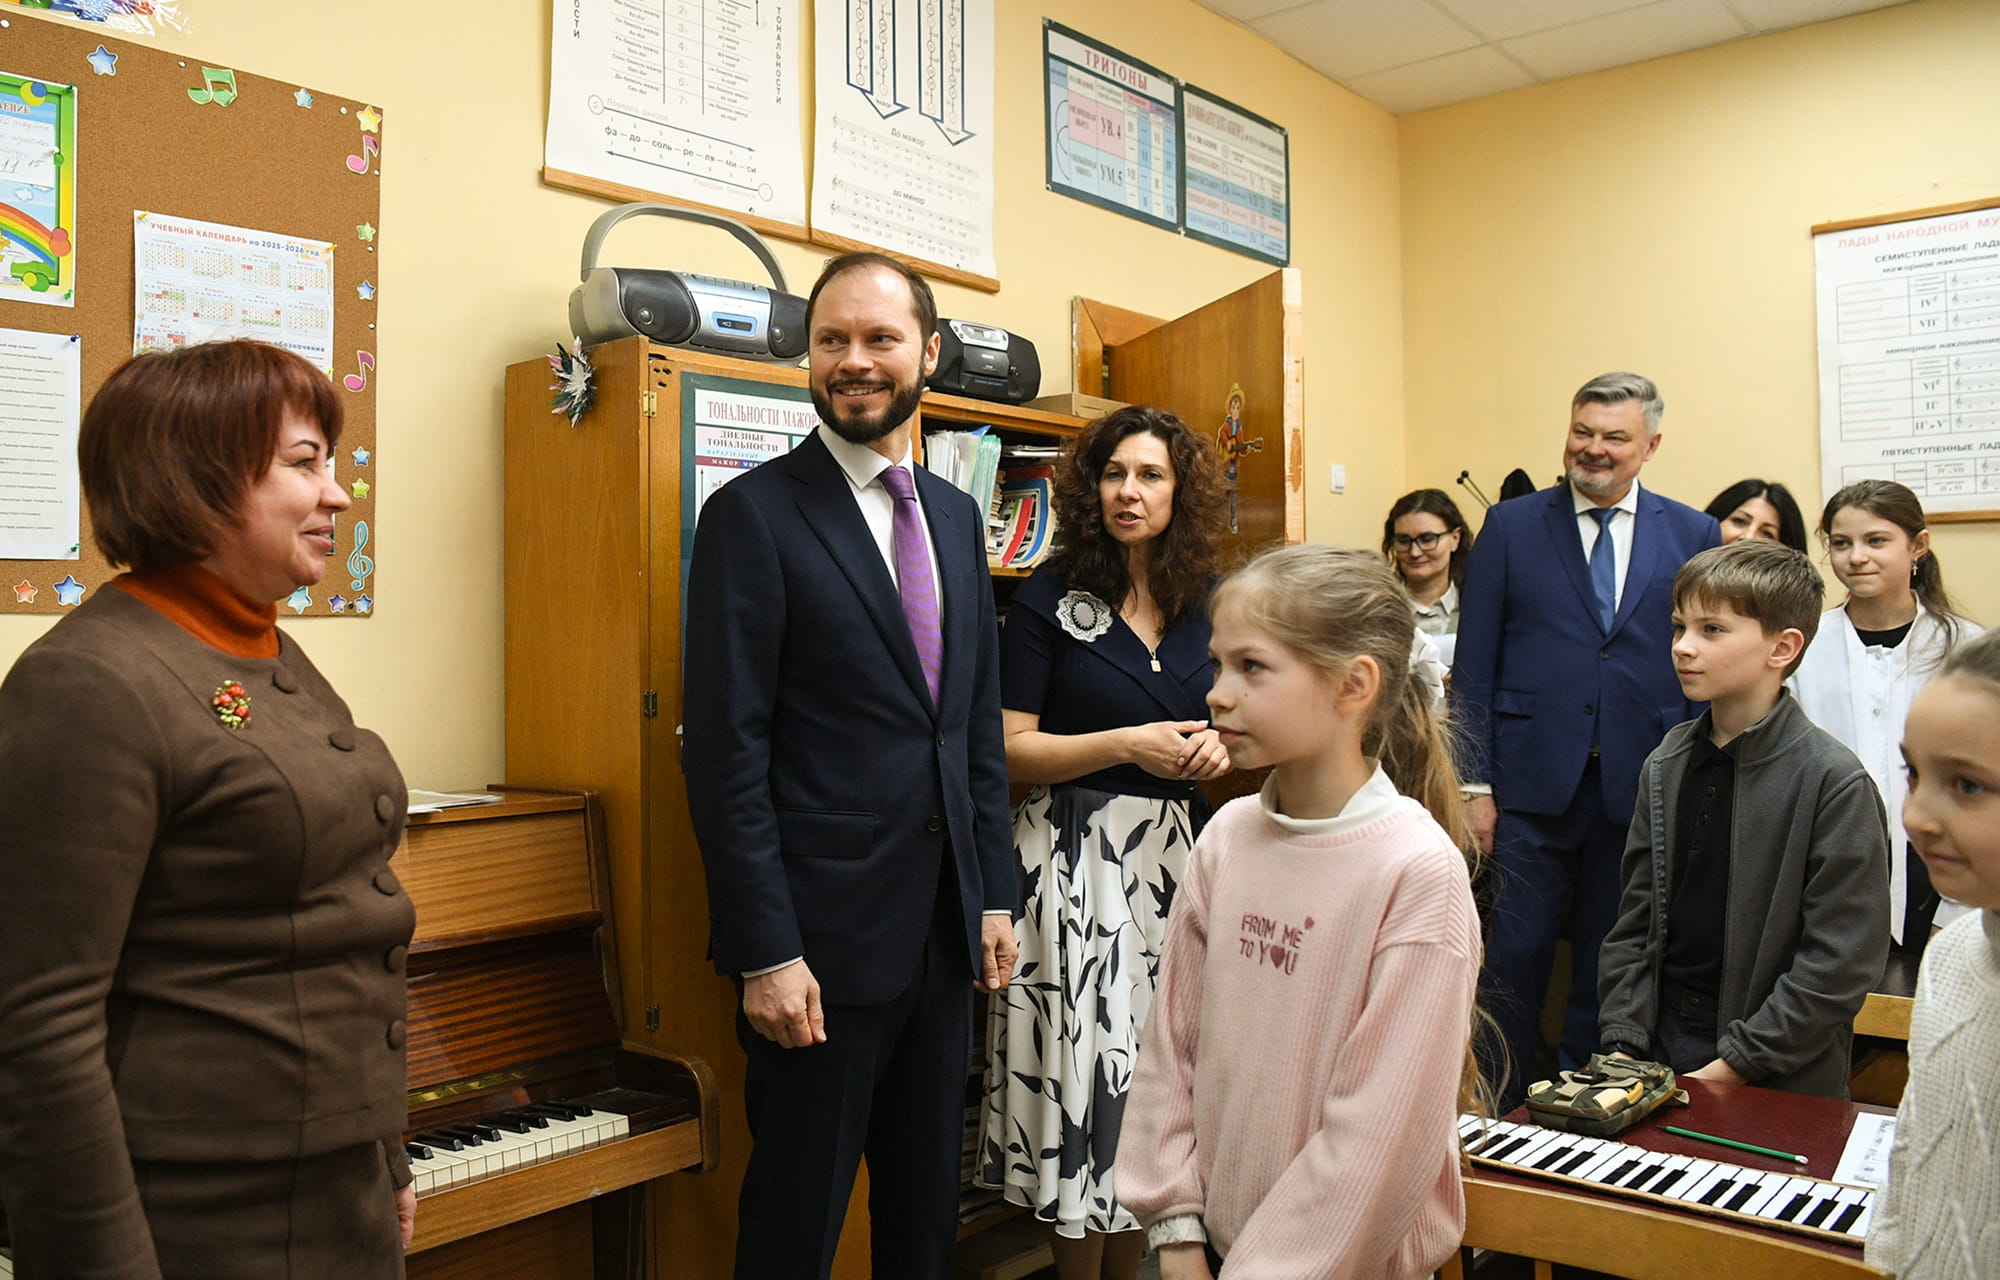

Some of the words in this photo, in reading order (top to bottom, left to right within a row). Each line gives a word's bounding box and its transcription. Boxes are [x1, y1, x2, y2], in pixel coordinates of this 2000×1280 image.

[1085, 50, 1148, 90] ТРИТОНЫ
[604, 125, 617, 136] фа
[629, 134, 641, 143] до
[652, 140, 672, 151] соль
[683, 148, 694, 158] ре
[150, 222, 194, 235] УЧЕБНЫЙ
[196, 229, 248, 244] КАЛЕНДАРЬ
[261, 240, 304, 254] 2025-2026
[1838, 234, 1879, 249] ЛАДЫ
[1886, 218, 1969, 241] НАРОДНОЙ
[1874, 243, 1968, 263] СЕМИСТУПЕННЫЕ
[1883, 261, 1934, 273] мажорное
[1936, 253, 1999, 266] наклонение
[707, 401, 779, 426] ТОНАЛЬНОСТИ
[707, 438, 778, 453] ТОНАЛЬНОСТИ
[720, 430, 765, 442] ДИЕЗНЫЕ
[1882, 444, 1973, 456] ПЯТИСТУПЕННЫЕ
[1241, 912, 1277, 939] FROM
[1282, 923, 1303, 949] ME
[1240, 938, 1254, 958] TO
